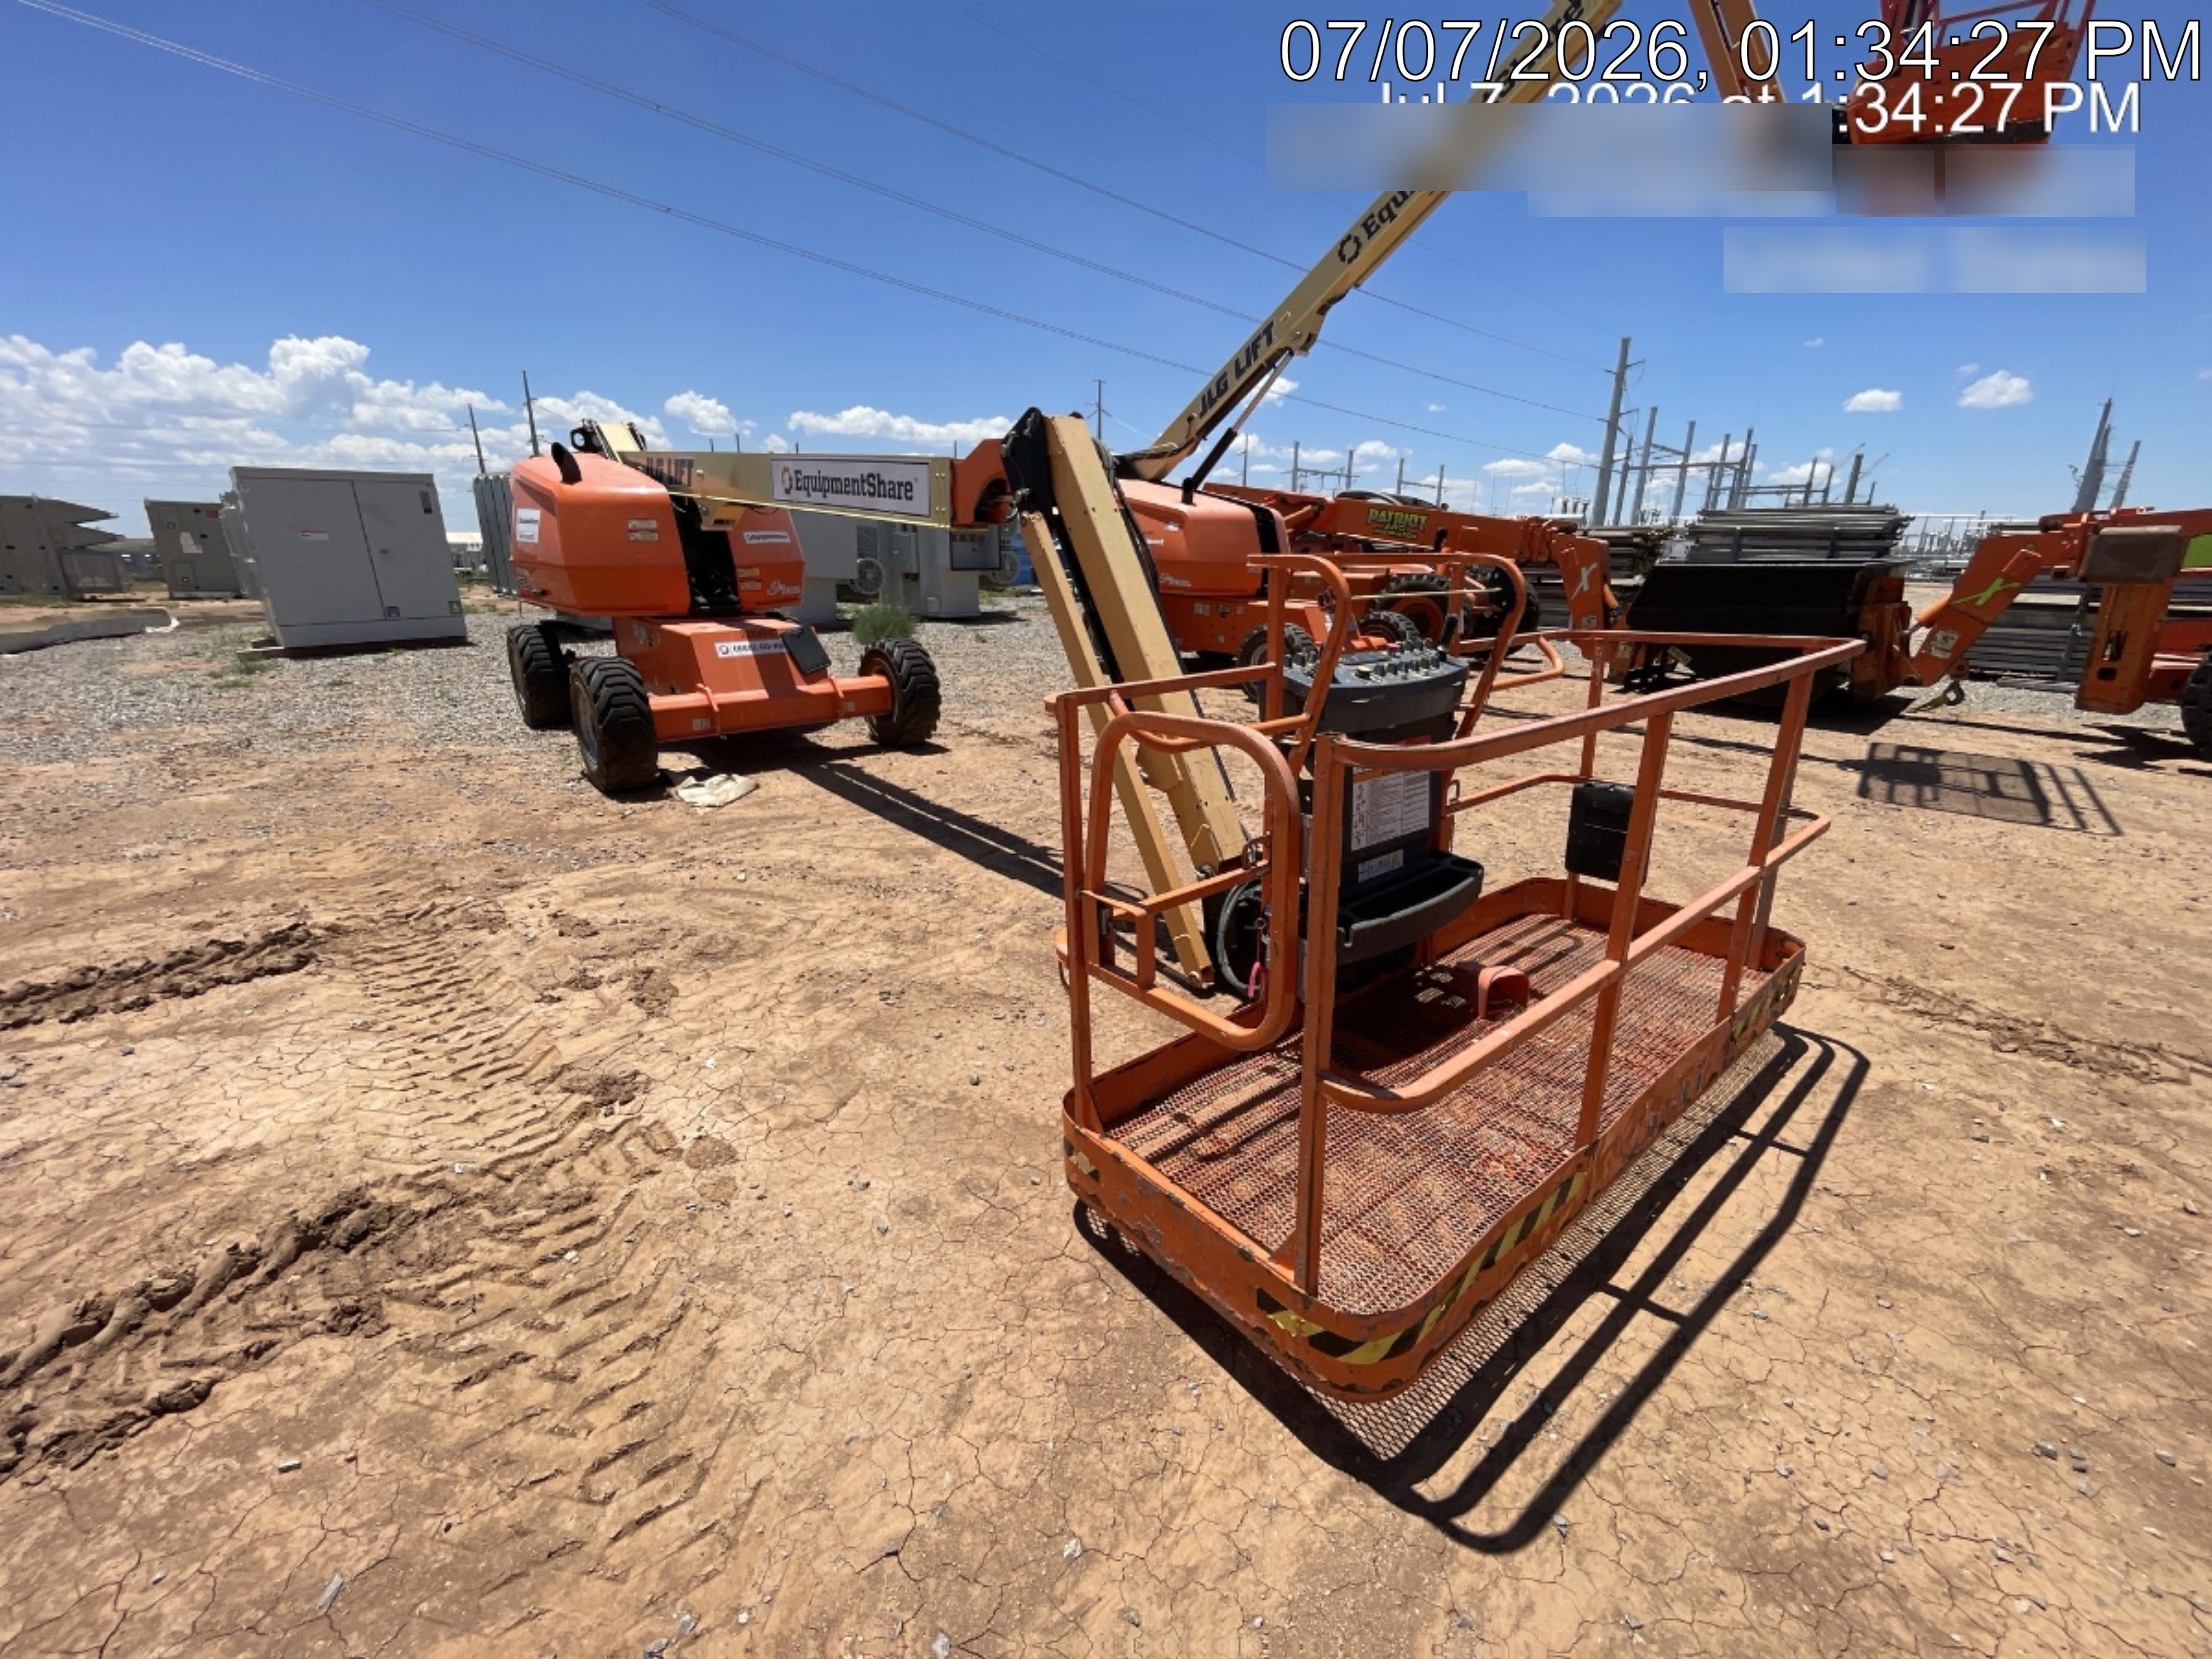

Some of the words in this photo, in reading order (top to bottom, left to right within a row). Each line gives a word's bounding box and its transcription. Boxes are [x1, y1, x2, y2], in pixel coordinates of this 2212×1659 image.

[1199, 371, 1228, 418] JLG
[1234, 320, 1274, 380] LIFT
[794, 469, 914, 501] EquipmentShare
[1367, 508, 1429, 531] PATRIOT
